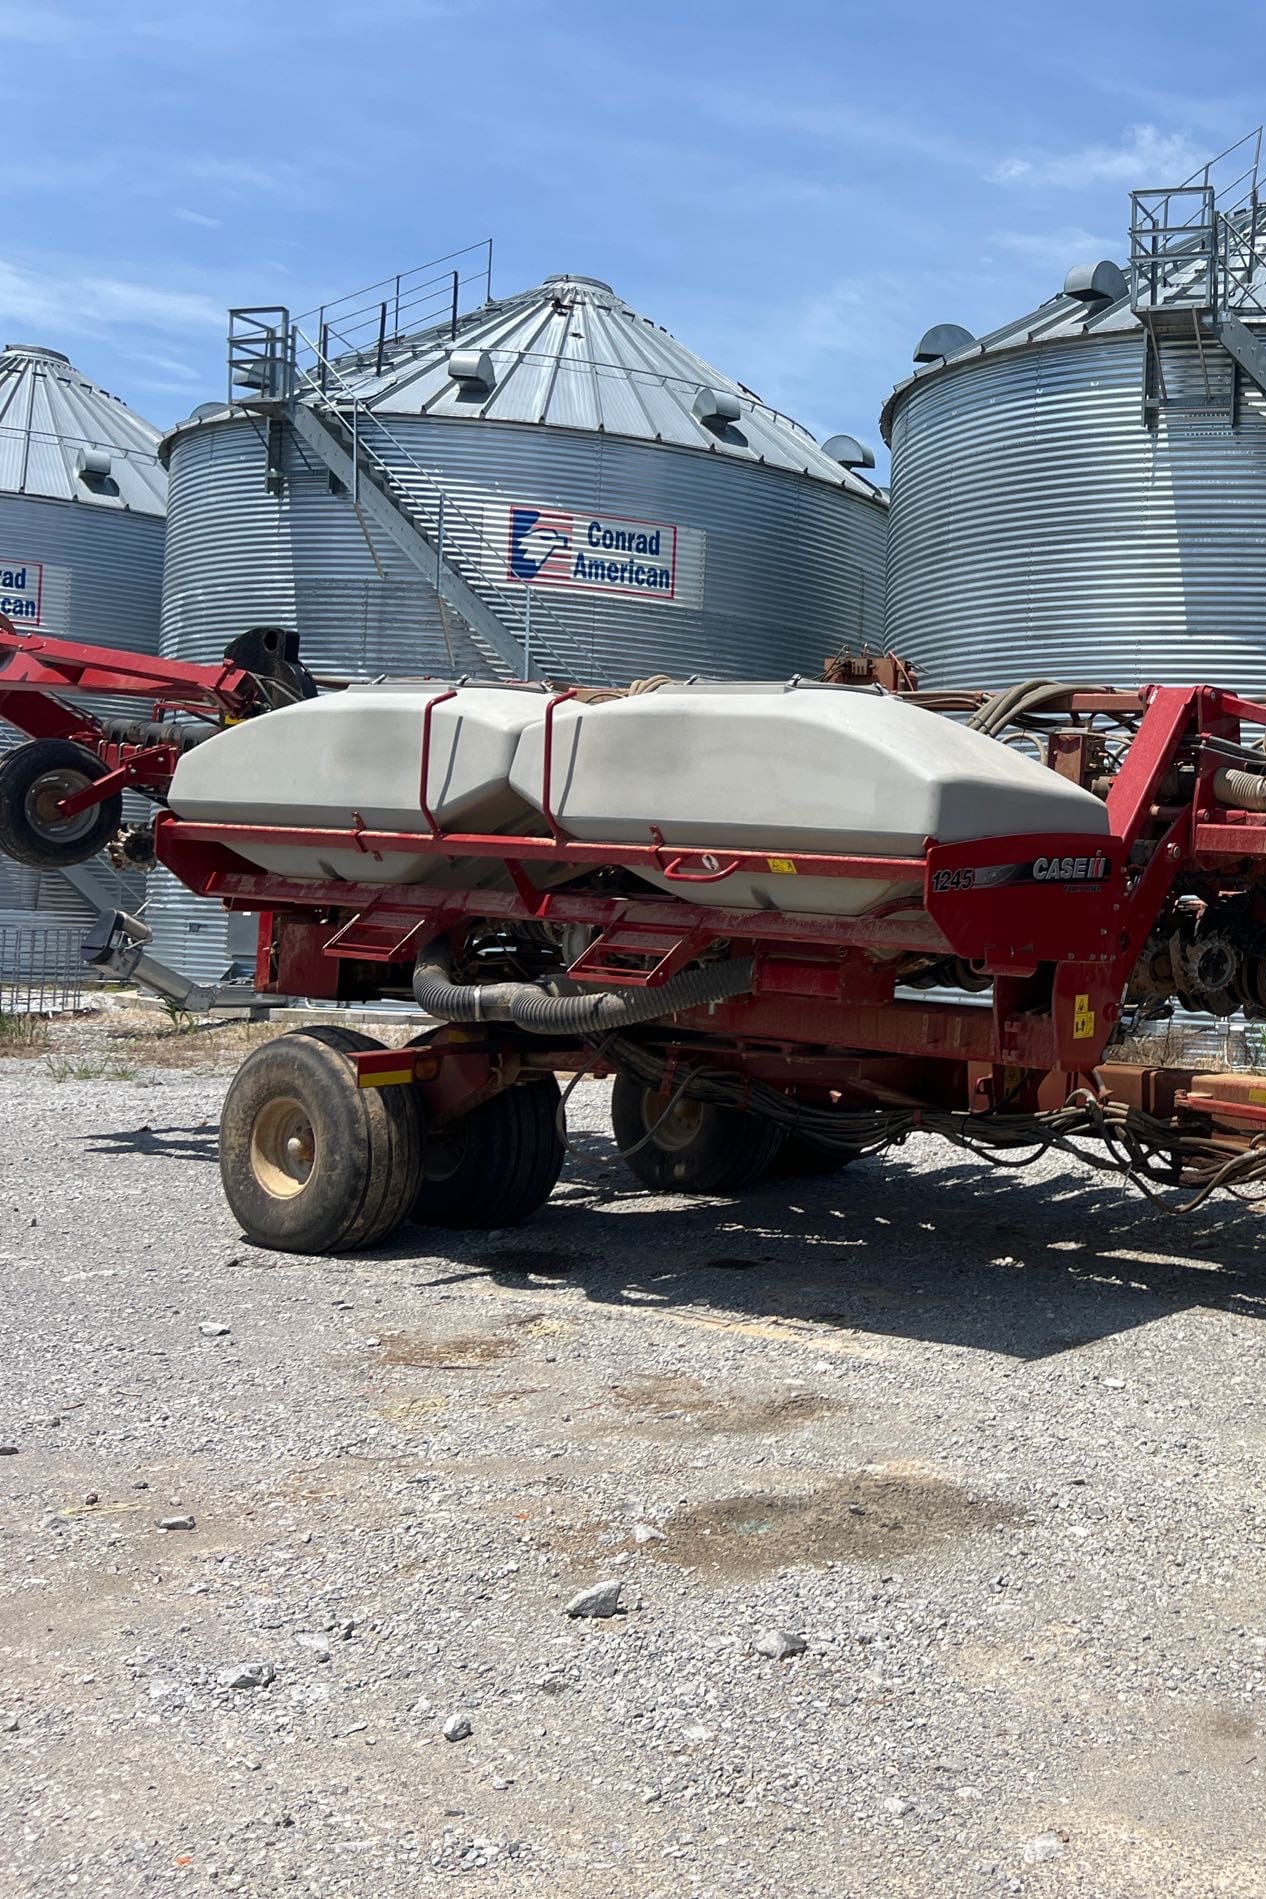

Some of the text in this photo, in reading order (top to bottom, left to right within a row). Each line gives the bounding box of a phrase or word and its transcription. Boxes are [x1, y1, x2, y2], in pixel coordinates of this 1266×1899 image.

[587, 520, 661, 556] Conrad
[0, 567, 27, 589] ad
[573, 551, 671, 589] American
[932, 867, 975, 892] 1245
